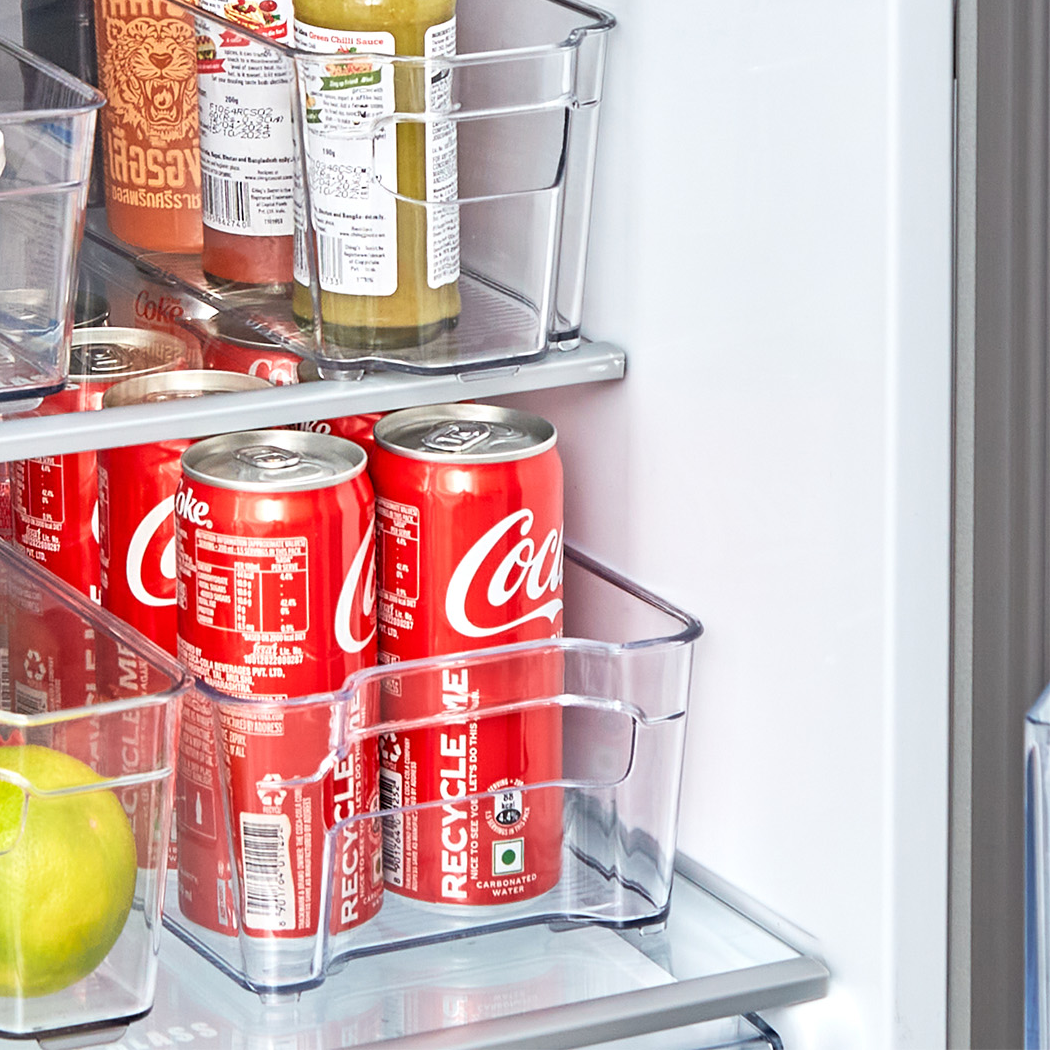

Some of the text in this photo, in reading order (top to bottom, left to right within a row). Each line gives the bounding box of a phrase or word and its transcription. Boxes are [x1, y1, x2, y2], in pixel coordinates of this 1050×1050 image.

[309, 31, 384, 46] Green Chilli Sauce
[174, 480, 214, 529] oke.
[214, 661, 251, 676] BEVERAGES
[252, 666, 268, 678] PVT.
[254, 721, 283, 733] ADDRESS
[468, 723, 479, 746] THIS
[468, 747, 479, 763] DO
[355, 764, 362, 780] DO
[468, 764, 479, 792] LET'S
[355, 781, 363, 809] LET'S
[503, 793, 514, 802] 88
[440, 733, 469, 899] RECYCLE
[469, 819, 480, 839] SEE
[334, 753, 359, 926] RECYCLE
[469, 841, 480, 855] TO
[469, 856, 480, 881] NICE
[476, 873, 537, 889] CARBONATED
[492, 885, 525, 897] WATER
